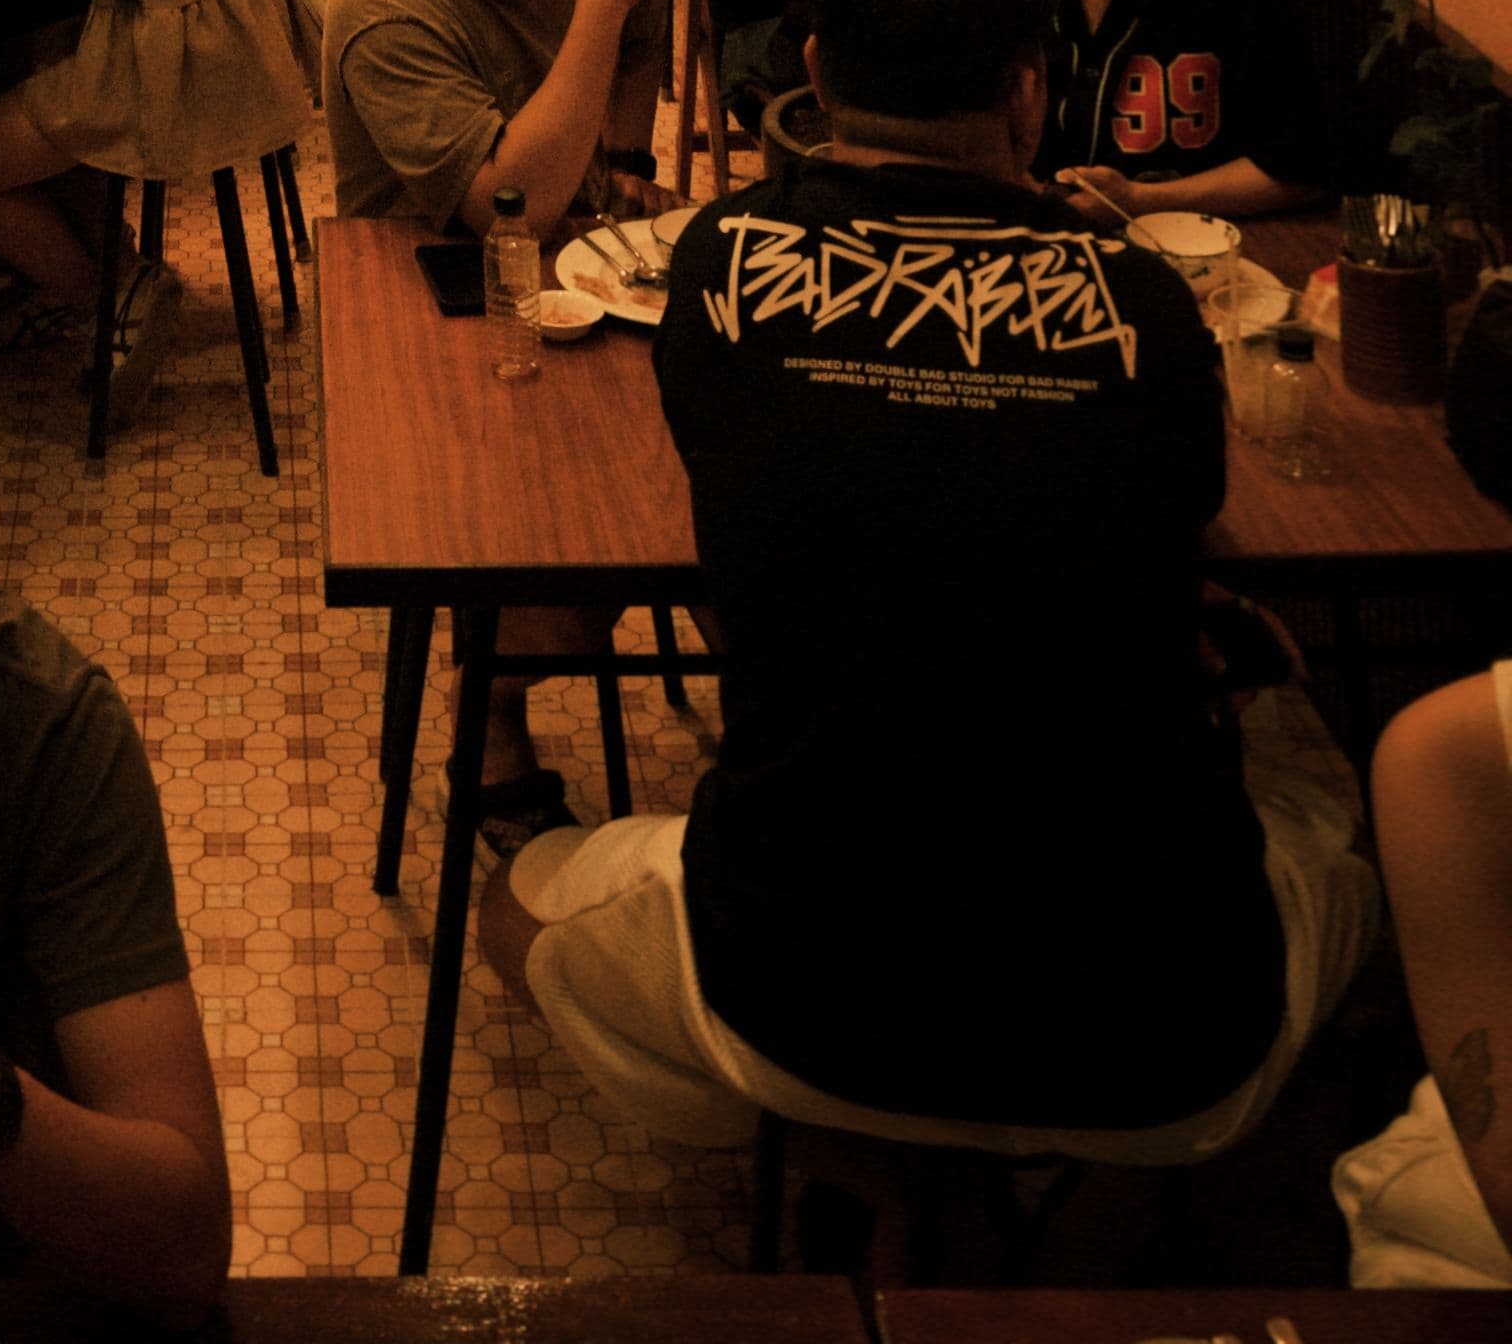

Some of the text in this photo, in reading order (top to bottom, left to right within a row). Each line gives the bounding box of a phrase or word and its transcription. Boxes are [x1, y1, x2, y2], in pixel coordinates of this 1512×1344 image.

[1111, 51, 1222, 155] 99
[783, 357, 1099, 392] DESIGNED BY DOUBLE BAD STUDIO FOR BAD RABBIT
[809, 371, 1076, 403] INSPIRED BY TOYS FOR TOYS NOT FASHION
[887, 391, 997, 410] ALL ABOUT TOYS
